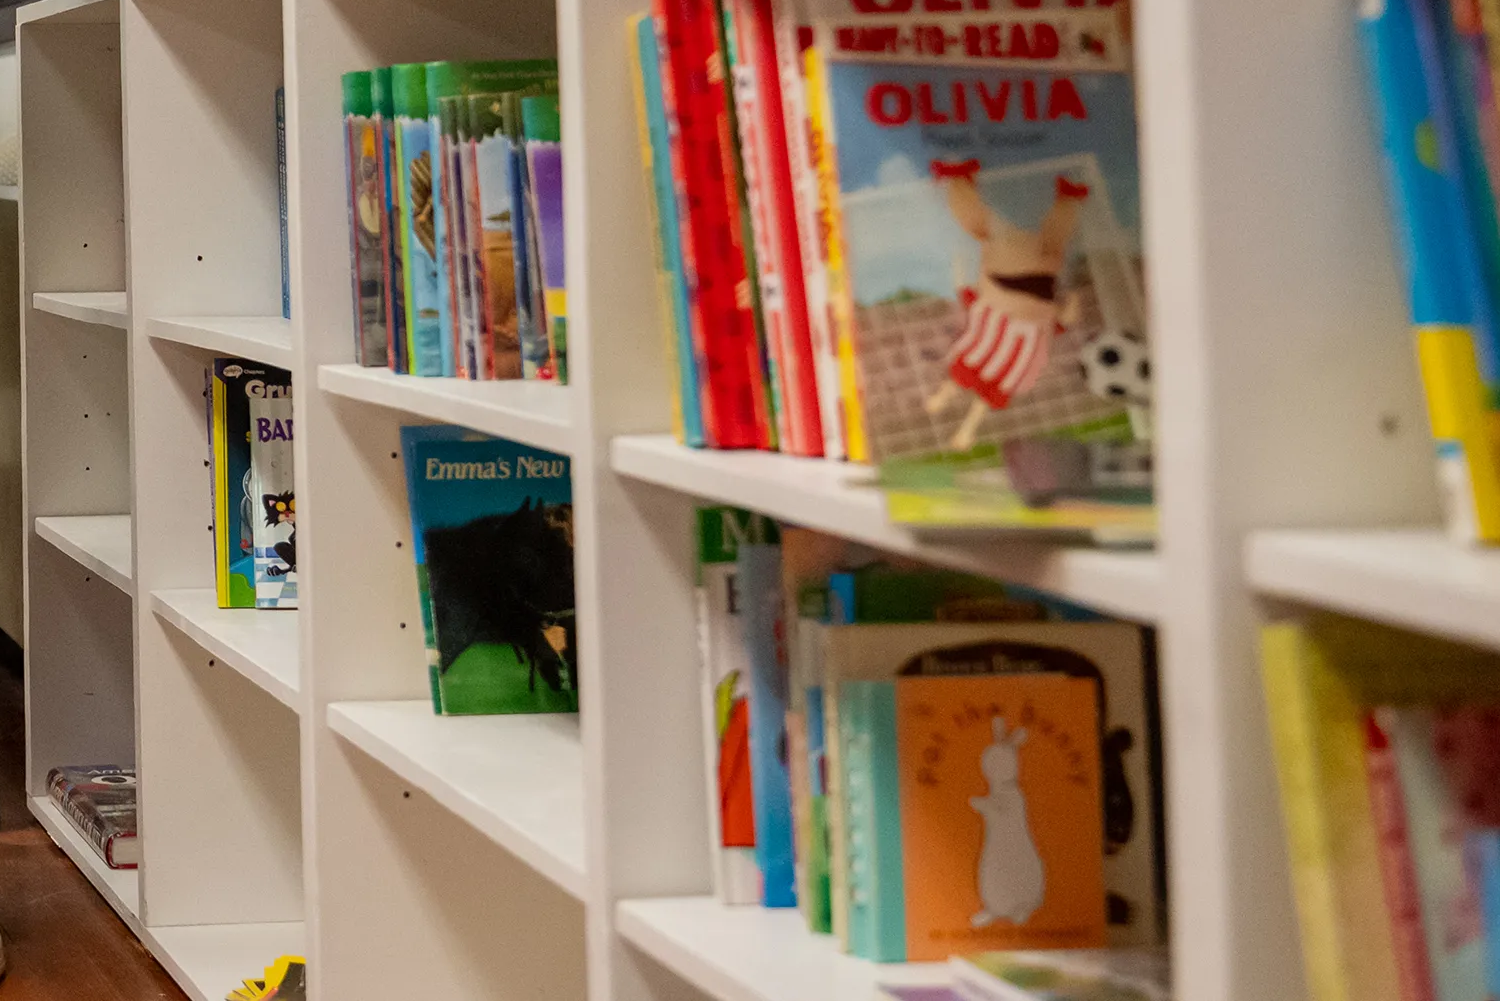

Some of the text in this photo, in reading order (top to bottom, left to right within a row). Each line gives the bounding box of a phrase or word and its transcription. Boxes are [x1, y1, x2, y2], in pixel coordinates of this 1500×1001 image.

[864, 77, 1088, 128] OLIVIA
[425, 456, 565, 480] Emma's New
